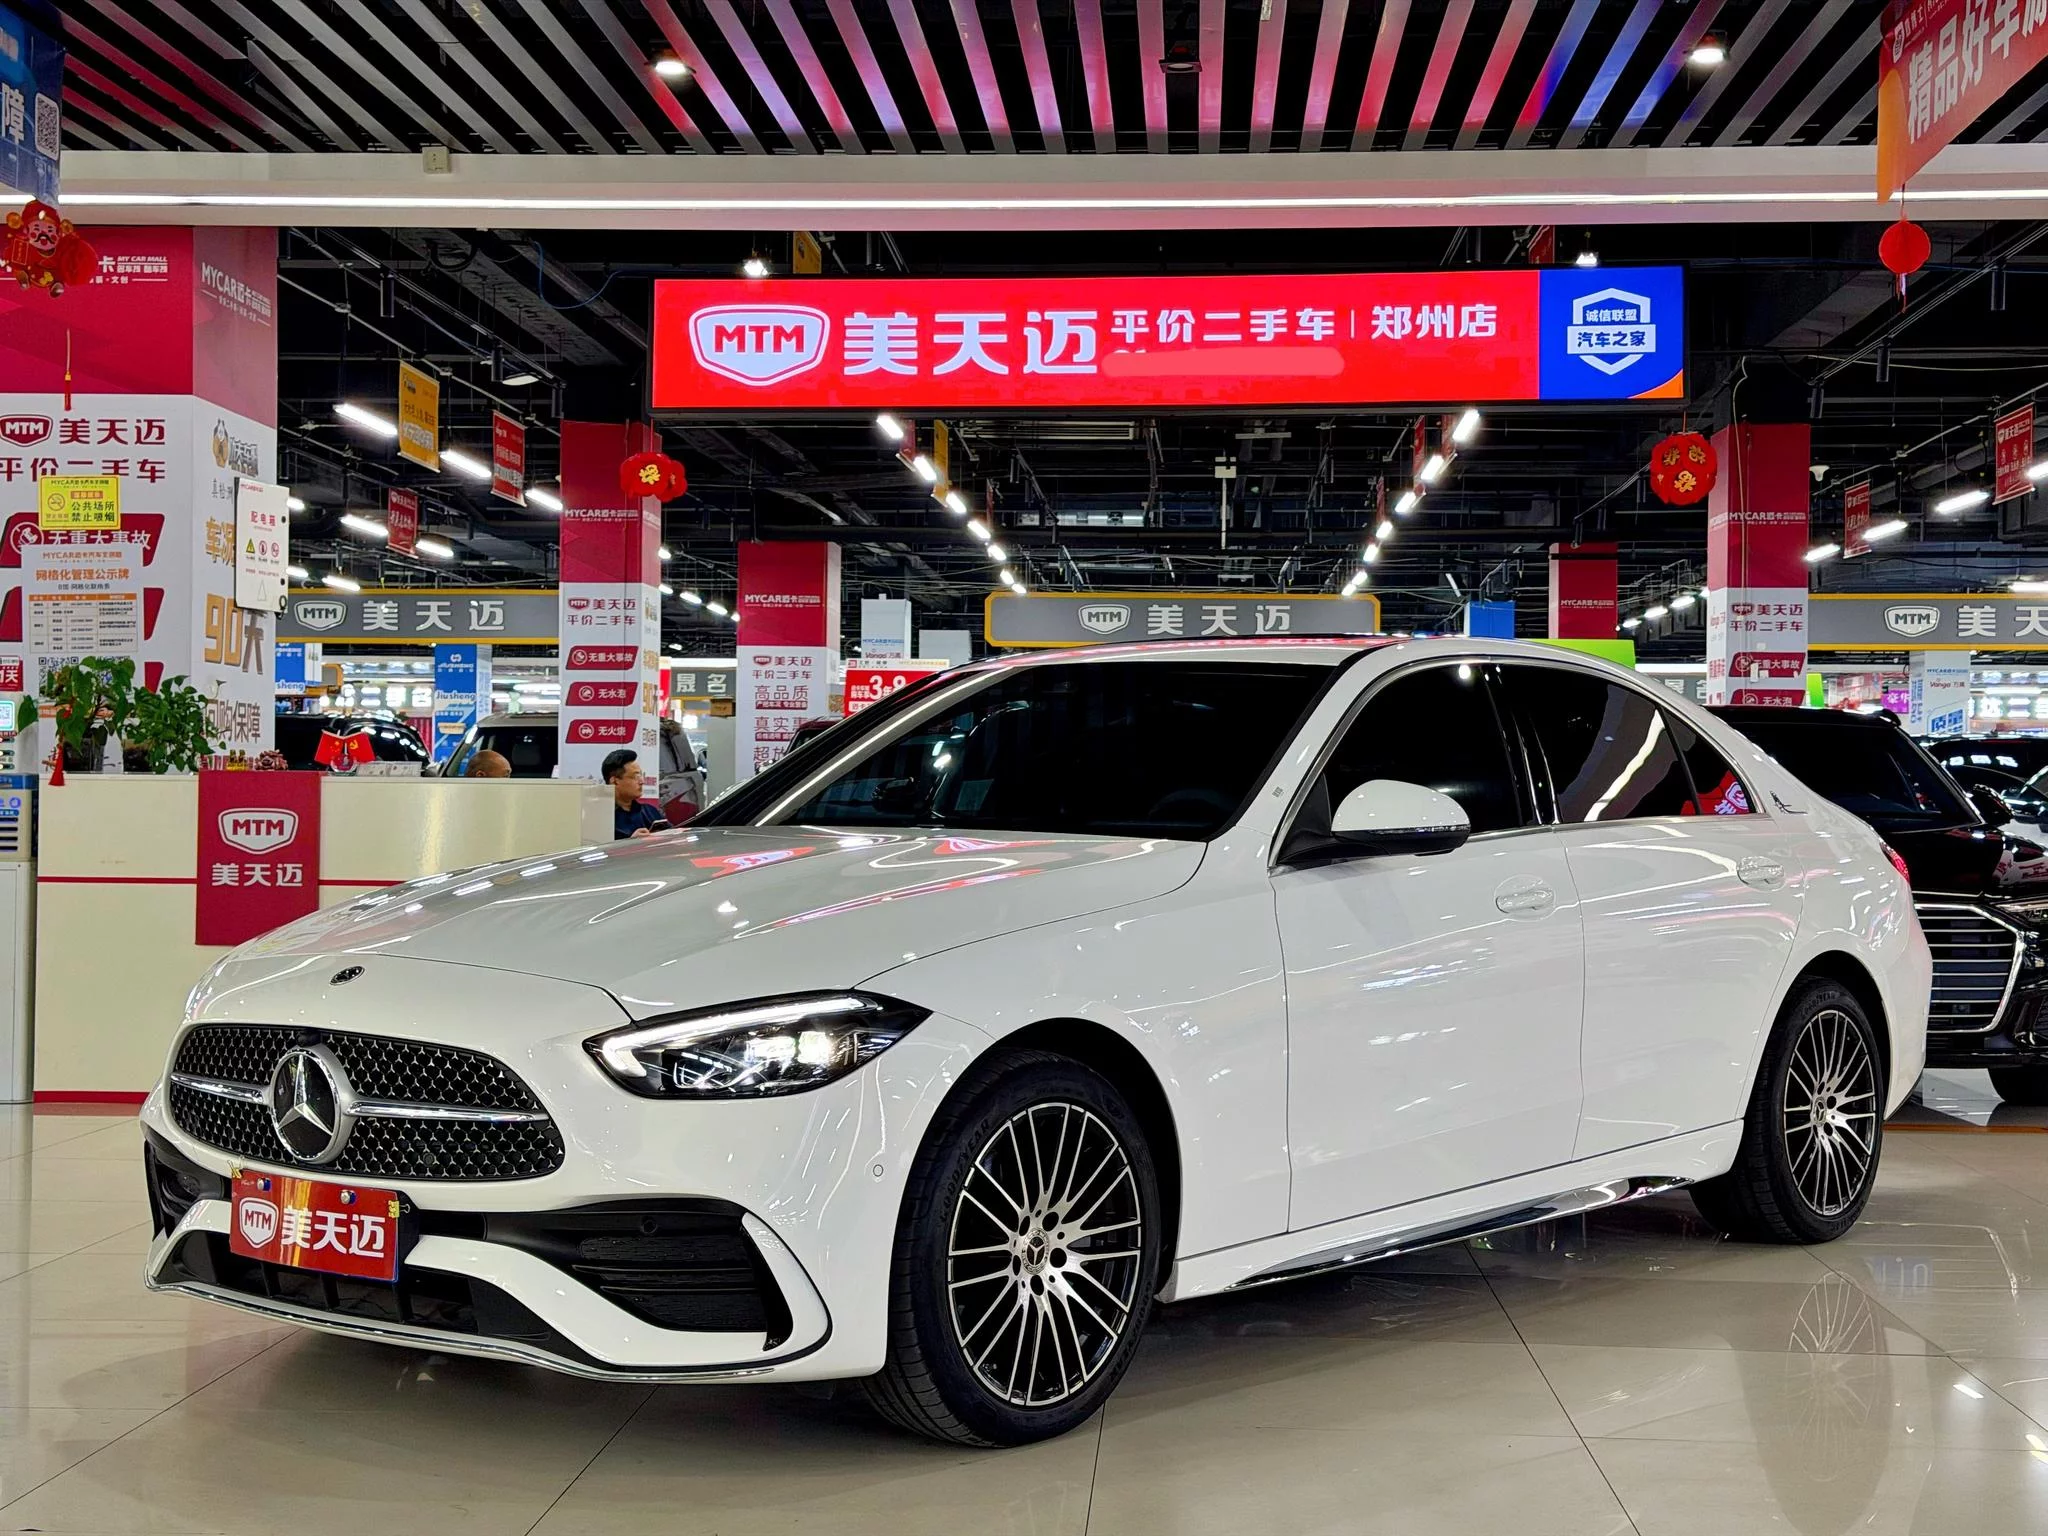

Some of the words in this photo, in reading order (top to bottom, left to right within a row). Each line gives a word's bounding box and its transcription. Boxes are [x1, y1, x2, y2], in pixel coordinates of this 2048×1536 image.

[1585, 308, 1638, 323] 诚信联盟
[1110, 306, 1336, 344] 平价二手车
[1371, 303, 1498, 340] 郑州店
[714, 325, 805, 353] MTM
[843, 311, 1099, 375] 美天迈
[1576, 331, 1647, 348] 汽车之家
[5, 422, 44, 435] MTM
[59, 418, 166, 445] 美天迈
[71, 501, 115, 511] 公共场所
[71, 512, 115, 523] 禁止吸烟
[48, 529, 152, 550] 无重大事故
[36, 568, 130, 581] 网格化管理公示牌
[593, 599, 636, 610] 美天迈
[1757, 604, 1803, 616] 美天迈
[303, 607, 338, 619] MTM
[362, 600, 505, 631] 美天迈
[567, 615, 636, 626] 平价二手车
[1087, 611, 1122, 623] MTM
[1147, 604, 1291, 636] 美天迈
[1894, 613, 1931, 625] MTM
[1730, 620, 1803, 632] 平价二手车
[1957, 605, 2048, 637] 美天
[589, 652, 634, 662] 无重大事故
[774, 656, 812, 666] 美天迈
[752, 670, 812, 680] 平价二手车
[436, 690, 477, 702] Jiusheng
[754, 685, 808, 701] 高品质
[206, 698, 261, 744] 回购保障
[232, 819, 285, 836] MTM
[211, 862, 304, 888] 美天迈
[244, 1209, 273, 1232] MTM
[281, 1204, 386, 1259] 美天迈
